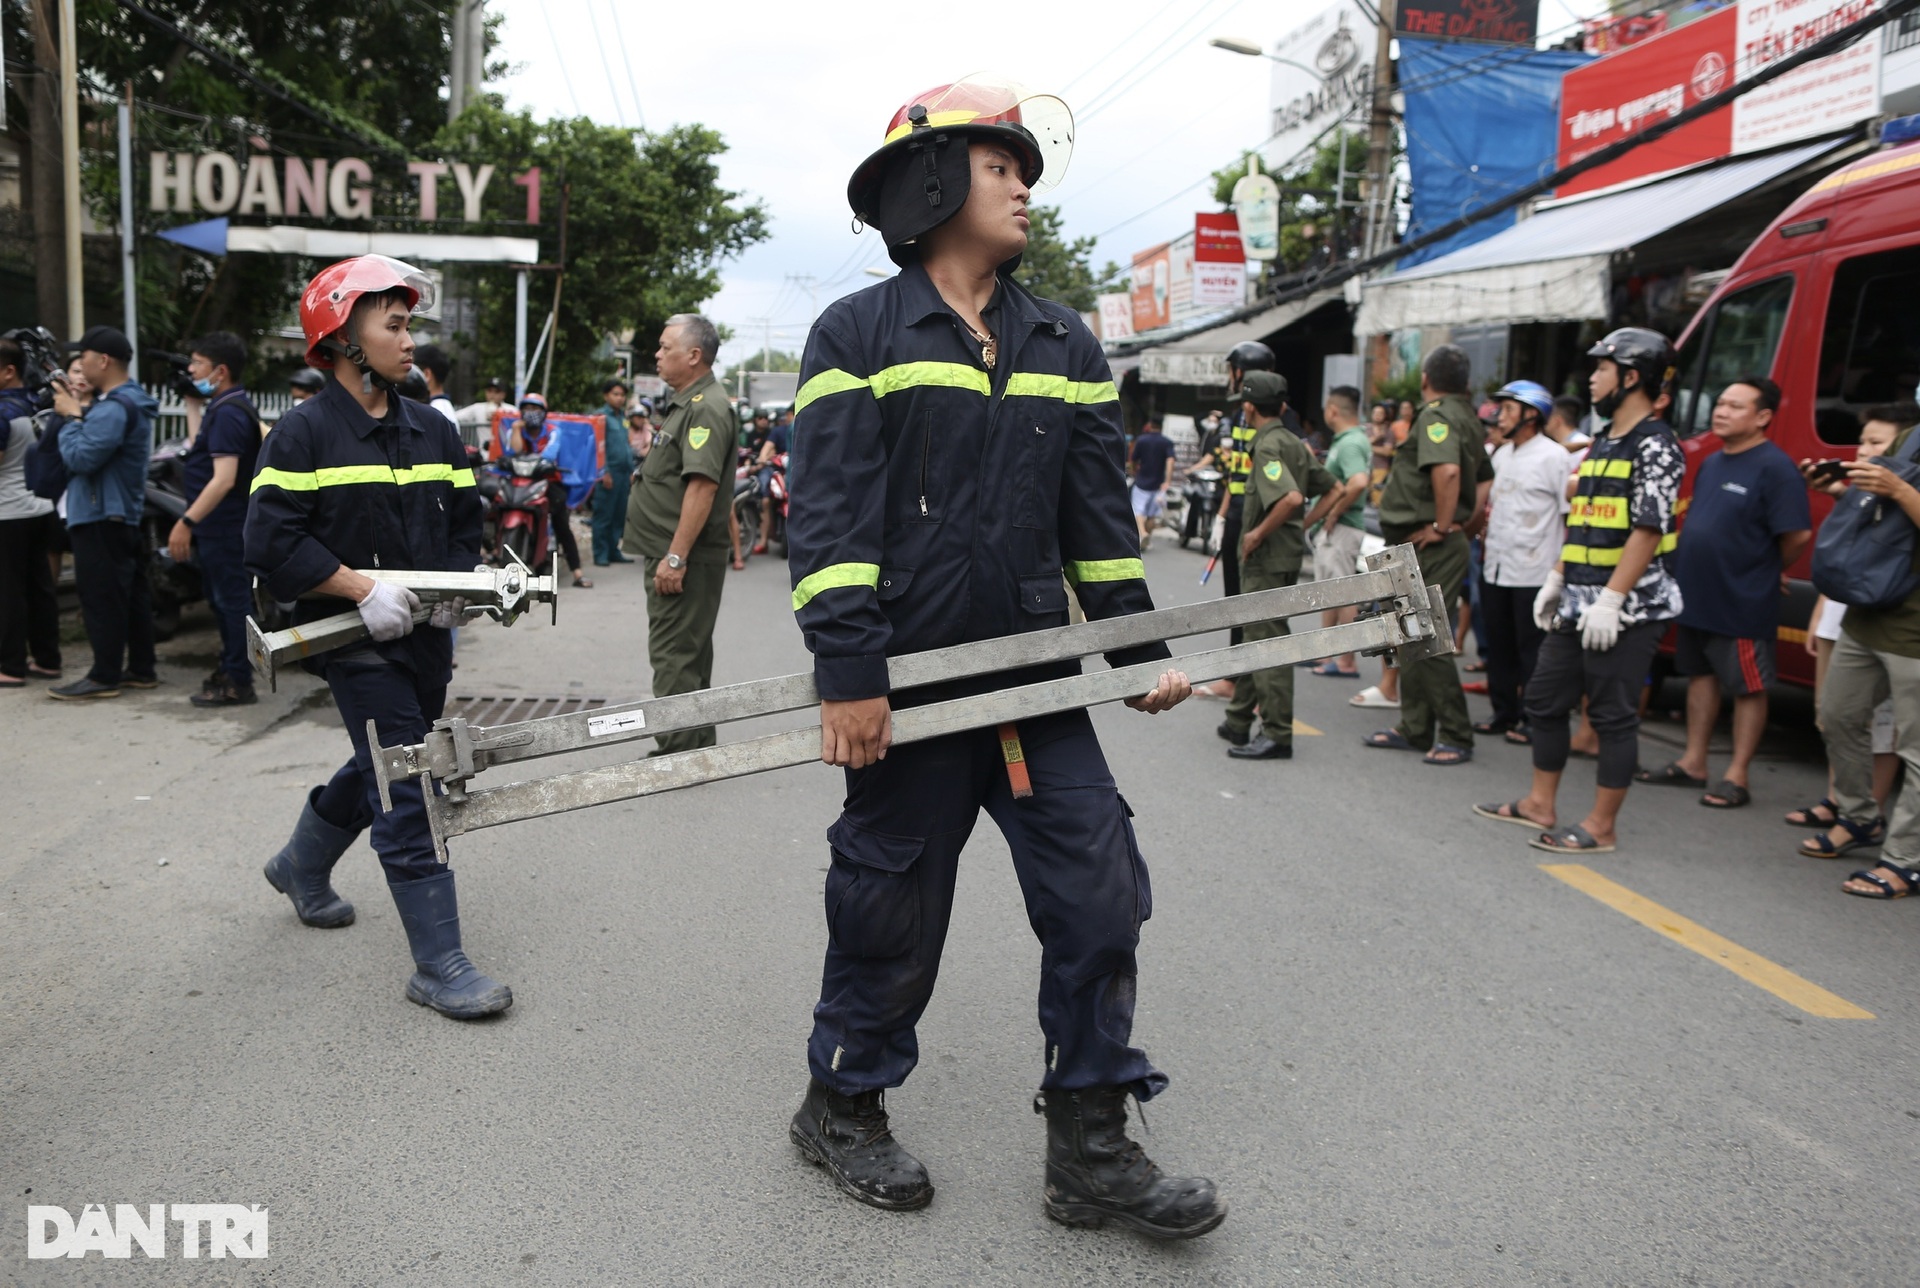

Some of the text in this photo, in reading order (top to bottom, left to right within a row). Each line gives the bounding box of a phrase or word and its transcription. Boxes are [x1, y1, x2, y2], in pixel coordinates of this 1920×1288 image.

[1404, 8, 1446, 33] THE
[149, 135, 541, 225] HOÀNG TY 1
